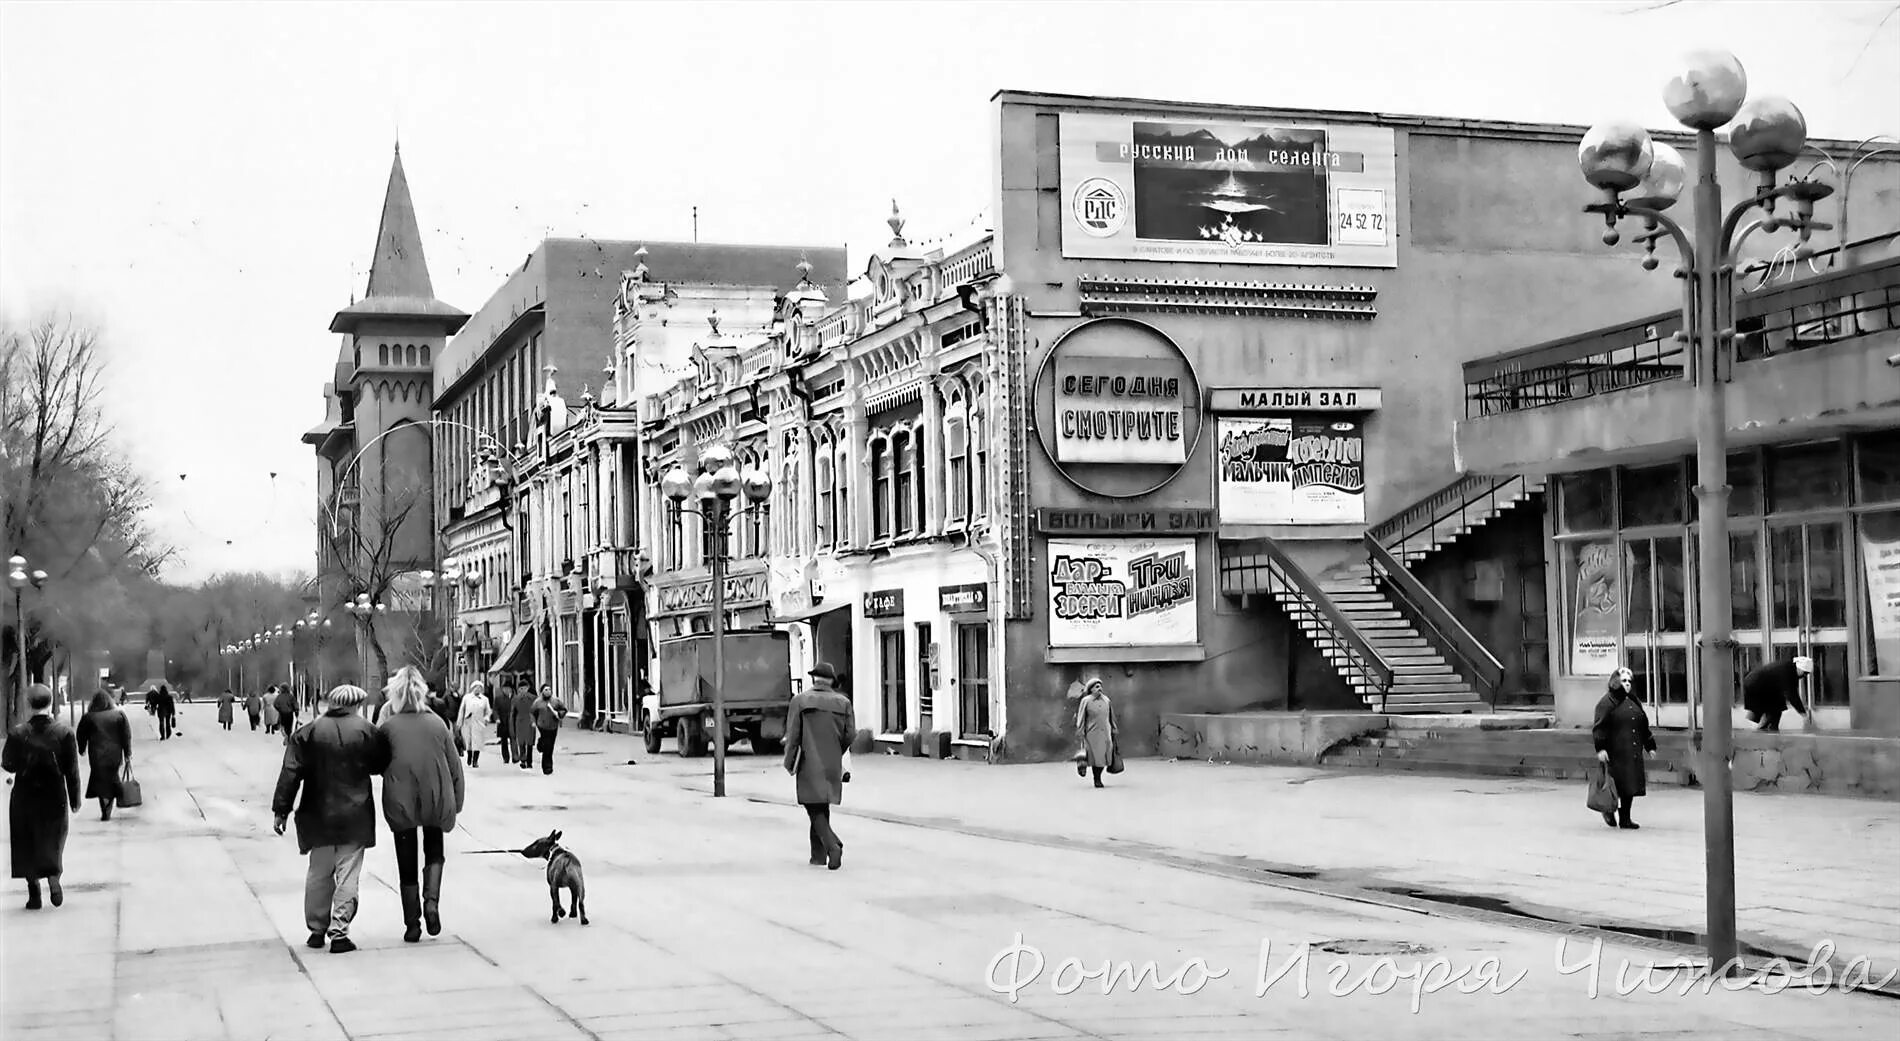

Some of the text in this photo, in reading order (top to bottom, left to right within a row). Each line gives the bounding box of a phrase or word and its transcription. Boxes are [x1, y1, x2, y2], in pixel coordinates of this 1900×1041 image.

[1340, 212, 1383, 230] 24 52 72
[1063, 375, 1179, 398] СЕГОДНЯ
[1240, 391, 1357, 406] МАЛЫЙ ЗАЛ
[1062, 410, 1180, 441] СМОТРИТЕ
[1169, 512, 1213, 529] ЗАЛ
